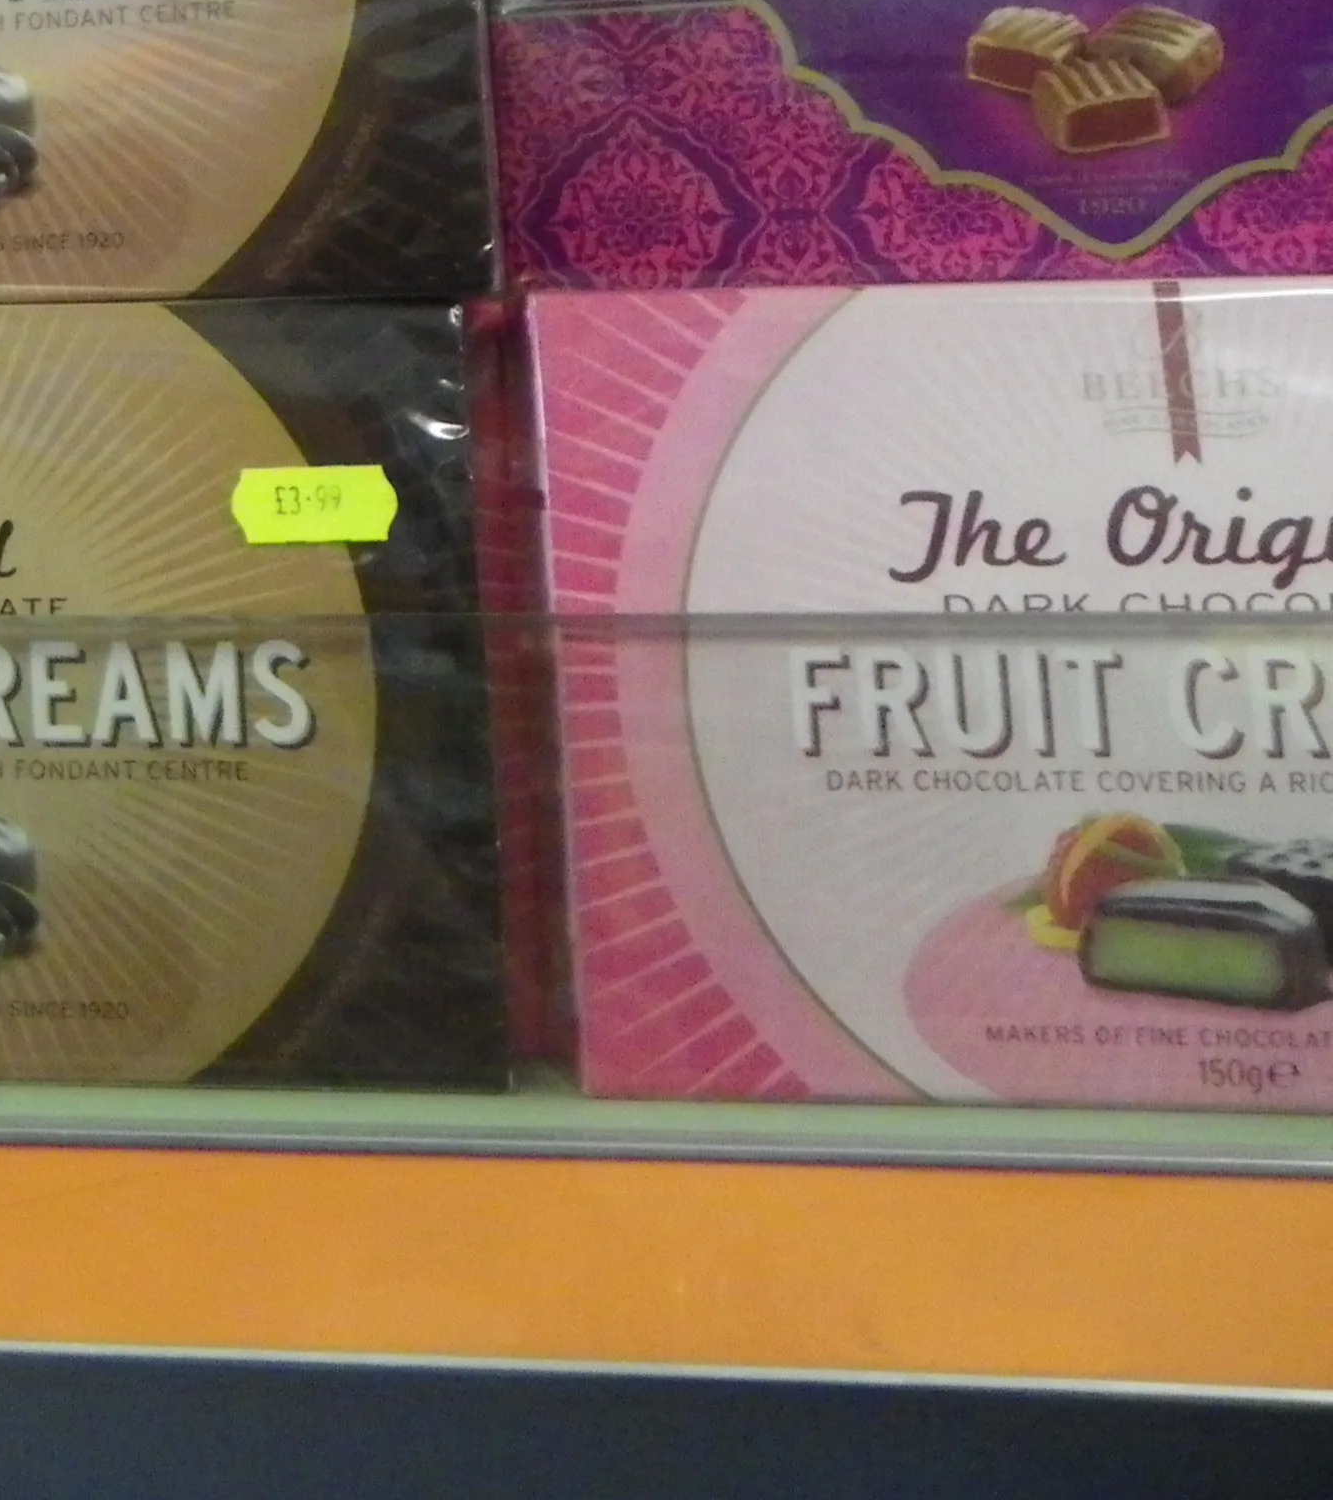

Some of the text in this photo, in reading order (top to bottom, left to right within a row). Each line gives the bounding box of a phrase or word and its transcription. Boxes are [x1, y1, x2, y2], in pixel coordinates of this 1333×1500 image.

[15, 5, 129, 31] FONDANT
[139, 0, 236, 24] CENTRE
[12, 233, 70, 252] SINCE
[78, 231, 125, 250] 1920
[888, 485, 1333, 590] The Orig
[790, 645, 1124, 760] FRUIT
[14, 759, 136, 780] FONDANT
[146, 759, 249, 781] CENTRE
[826, 768, 903, 792] DARK
[914, 769, 1085, 792] CHOCOLATE
[1097, 769, 1247, 793] COVERING
[1258, 770, 1277, 792] A
[9, 1000, 73, 1020] SINCE
[79, 1001, 130, 1021] 1920
[986, 1026, 1083, 1044] MAKERS
[1094, 1026, 1124, 1045] OF
[1136, 1026, 1188, 1046] FINE
